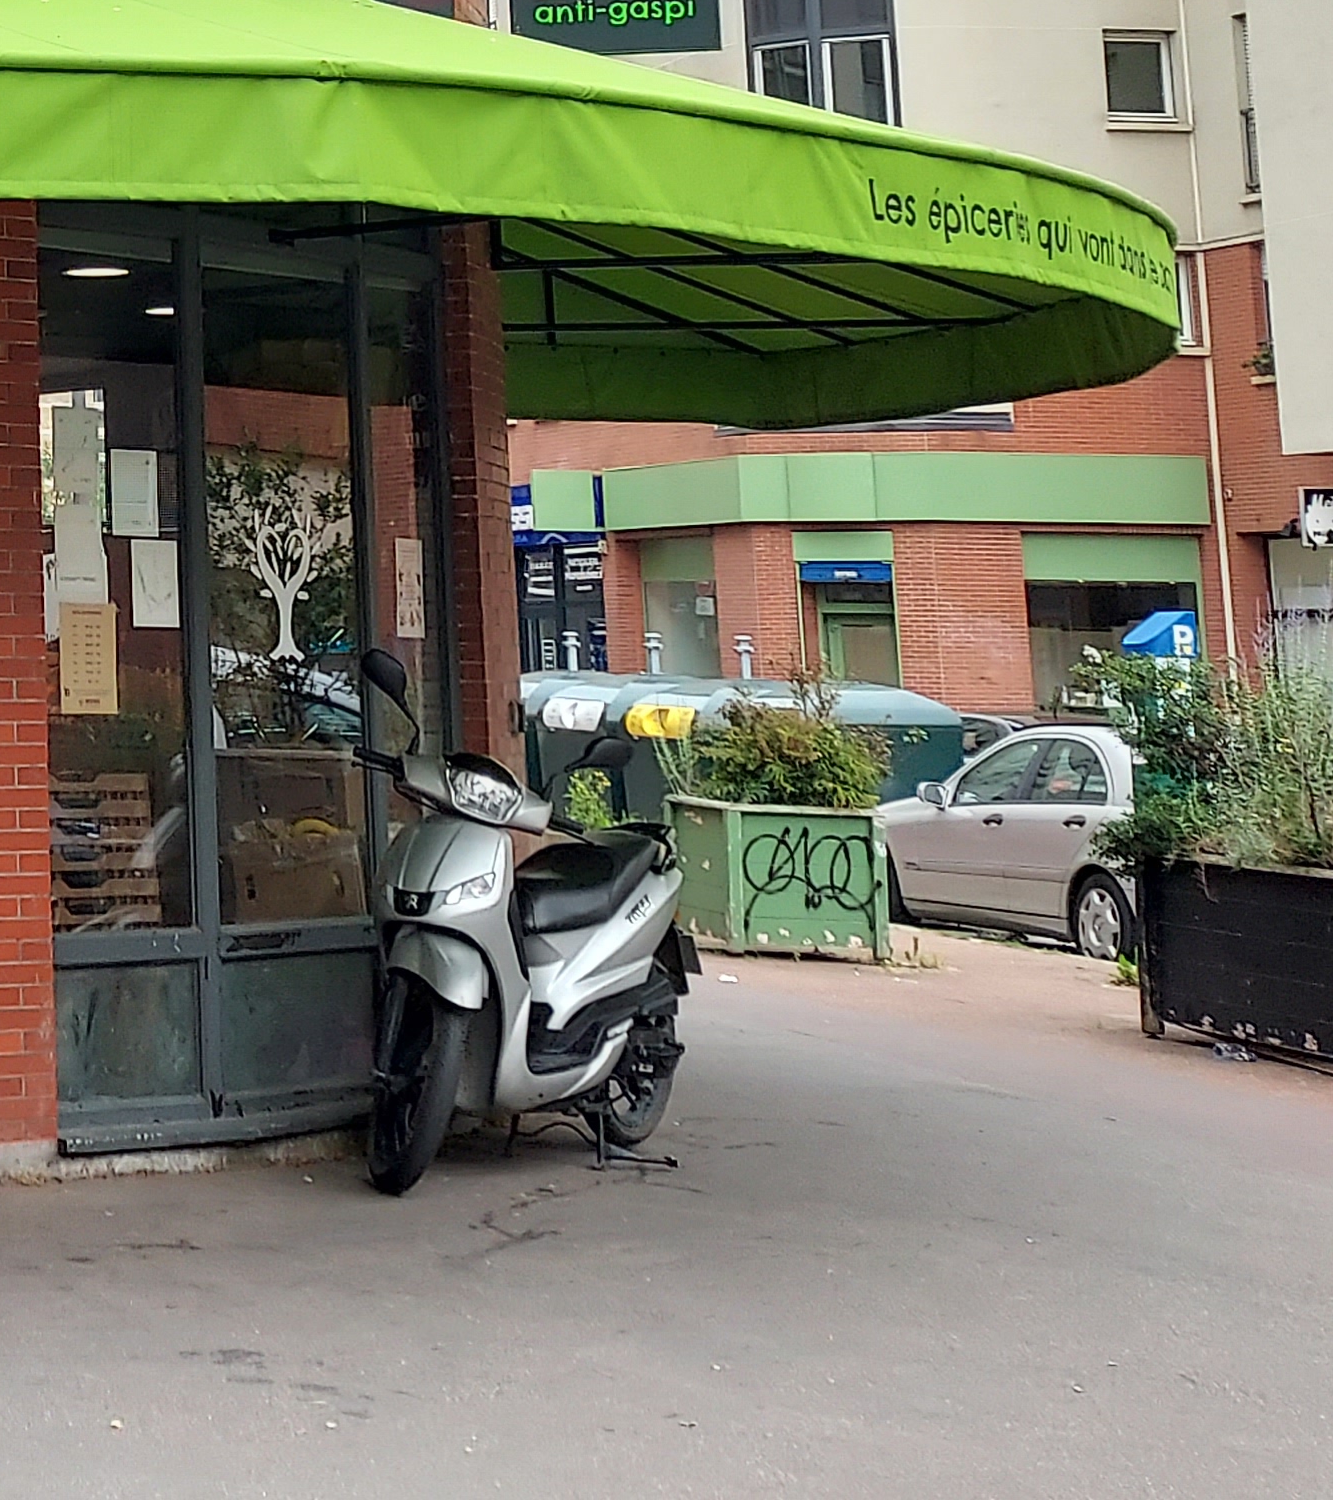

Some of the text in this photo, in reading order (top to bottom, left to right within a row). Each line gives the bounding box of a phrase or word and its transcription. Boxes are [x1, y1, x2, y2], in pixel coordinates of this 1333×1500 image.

[869, 179, 917, 228] Les
[928, 187, 1031, 245] épiceries
[1037, 216, 1073, 260] qui
[1078, 231, 1115, 267] vont
